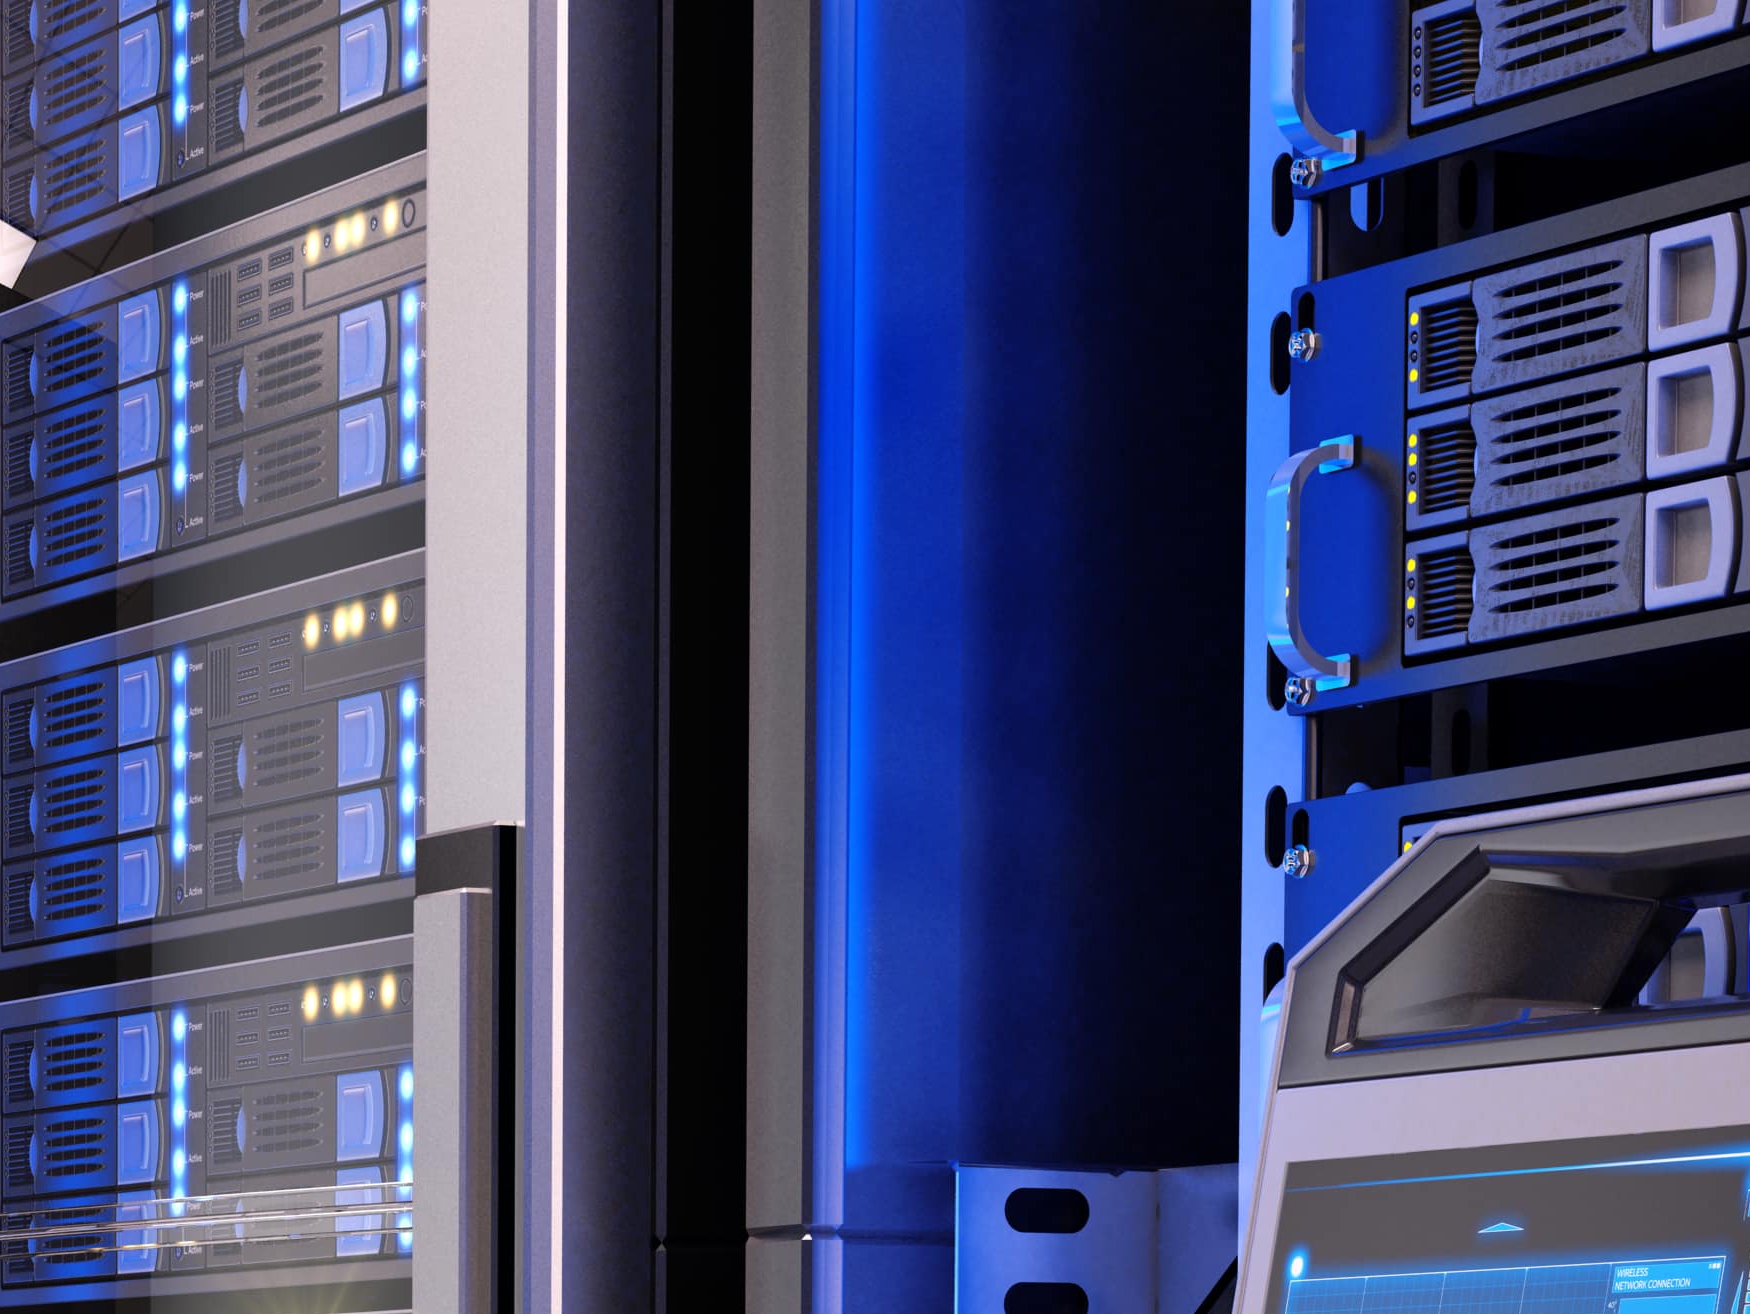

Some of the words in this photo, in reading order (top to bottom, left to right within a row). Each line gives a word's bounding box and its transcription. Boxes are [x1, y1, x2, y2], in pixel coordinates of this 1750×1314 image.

[1617, 1267, 1649, 1278] WIRELESS
[1615, 1280, 1647, 1291] NETWORK
[1647, 1277, 1691, 1289] CONNECTION
